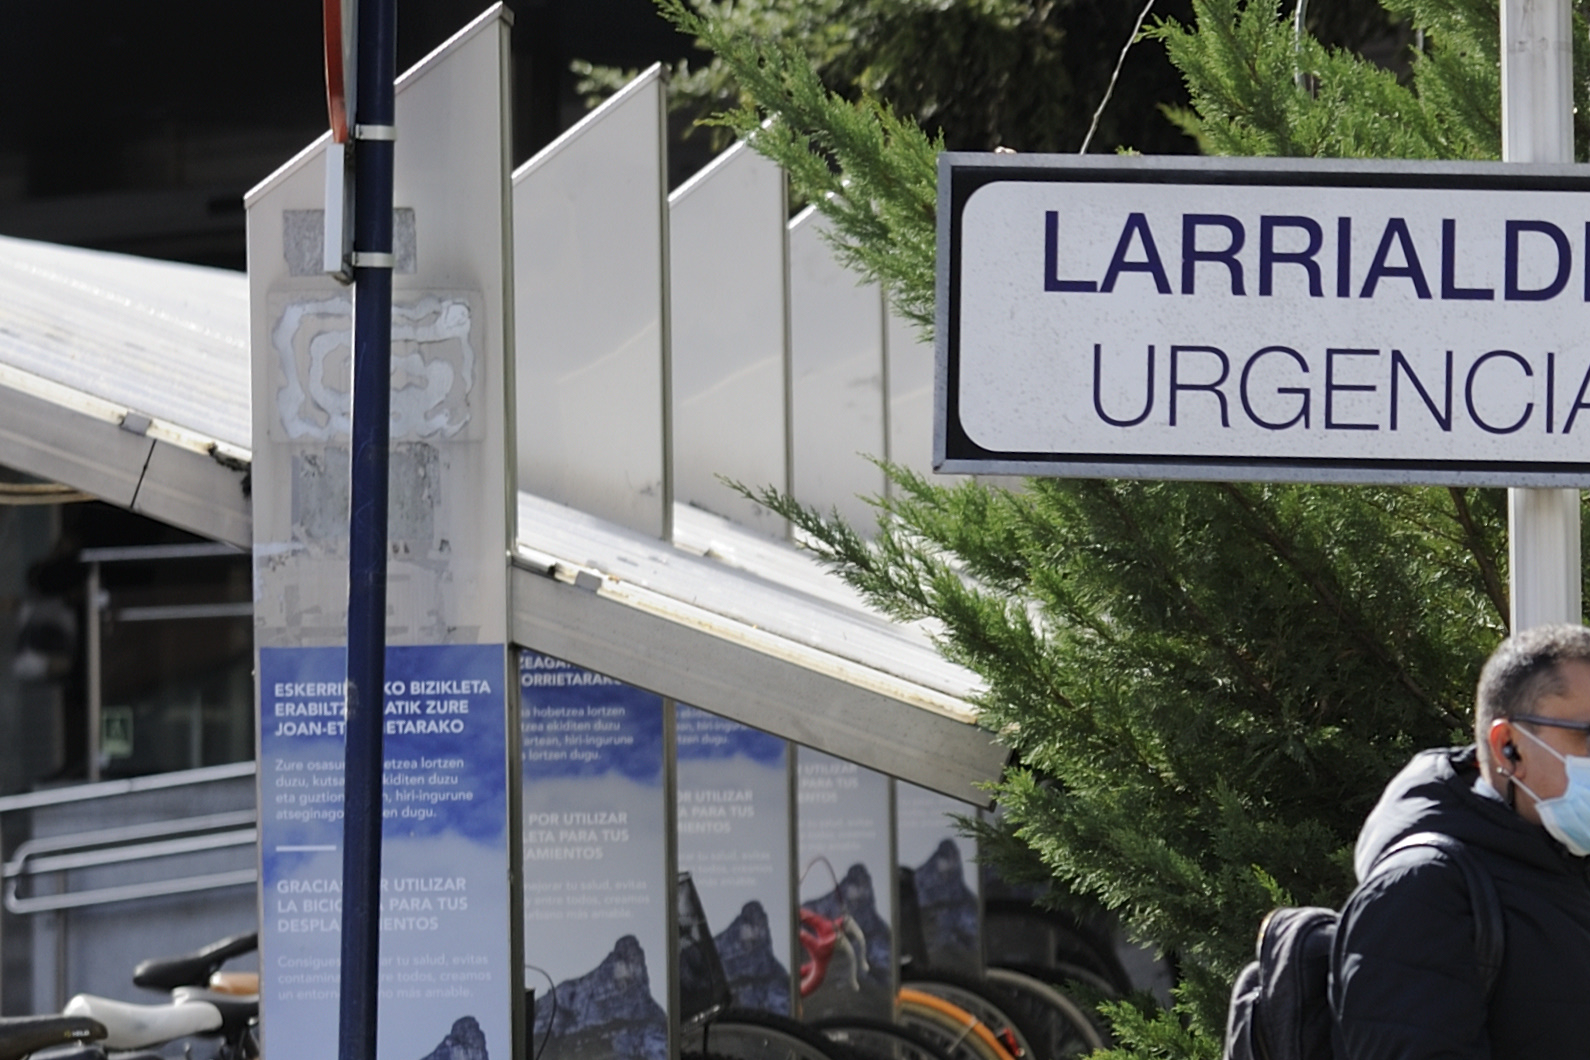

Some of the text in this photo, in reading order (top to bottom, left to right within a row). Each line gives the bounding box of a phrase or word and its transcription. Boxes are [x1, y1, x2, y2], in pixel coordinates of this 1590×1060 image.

[410, 680, 491, 695] BIZIKLETA
[426, 700, 469, 714] ZURE
[275, 758, 304, 771] Zure
[307, 761, 345, 771] osasu
[421, 756, 464, 769] lortzen
[275, 773, 458, 788] duzu, kutsa kiditen duzu
[275, 793, 295, 803] eta
[396, 789, 473, 805] hiri-ingurune
[276, 807, 344, 823] atseginago
[402, 806, 437, 821] dugu.
[528, 812, 628, 826] POR UTILIZAR
[559, 830, 599, 843] PARA
[602, 829, 629, 843] TUS
[277, 879, 343, 893] GRACIA
[394, 877, 466, 892] UTILIZAR
[278, 900, 298, 913] LA
[390, 898, 432, 911] PARA
[437, 897, 468, 911] TUS
[297, 988, 341, 1000] entorn
